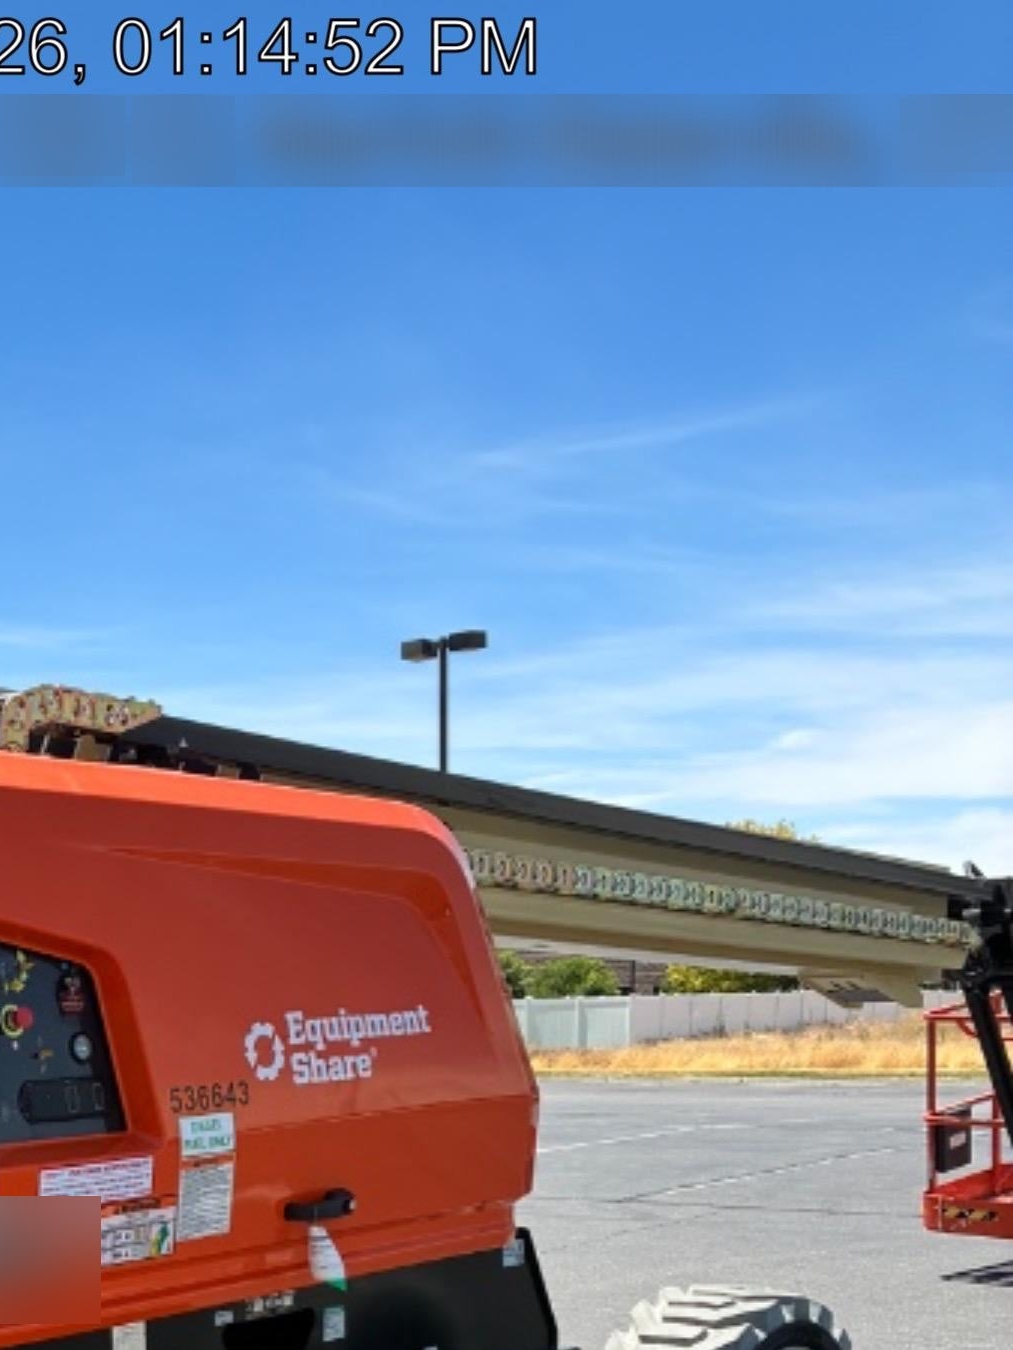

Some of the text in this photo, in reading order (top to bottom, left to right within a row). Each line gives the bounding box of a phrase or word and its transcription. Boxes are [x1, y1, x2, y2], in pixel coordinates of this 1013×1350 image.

[285, 1004, 431, 1050] Equipment
[291, 1050, 373, 1085] Share
[169, 1078, 249, 1113] 536643
